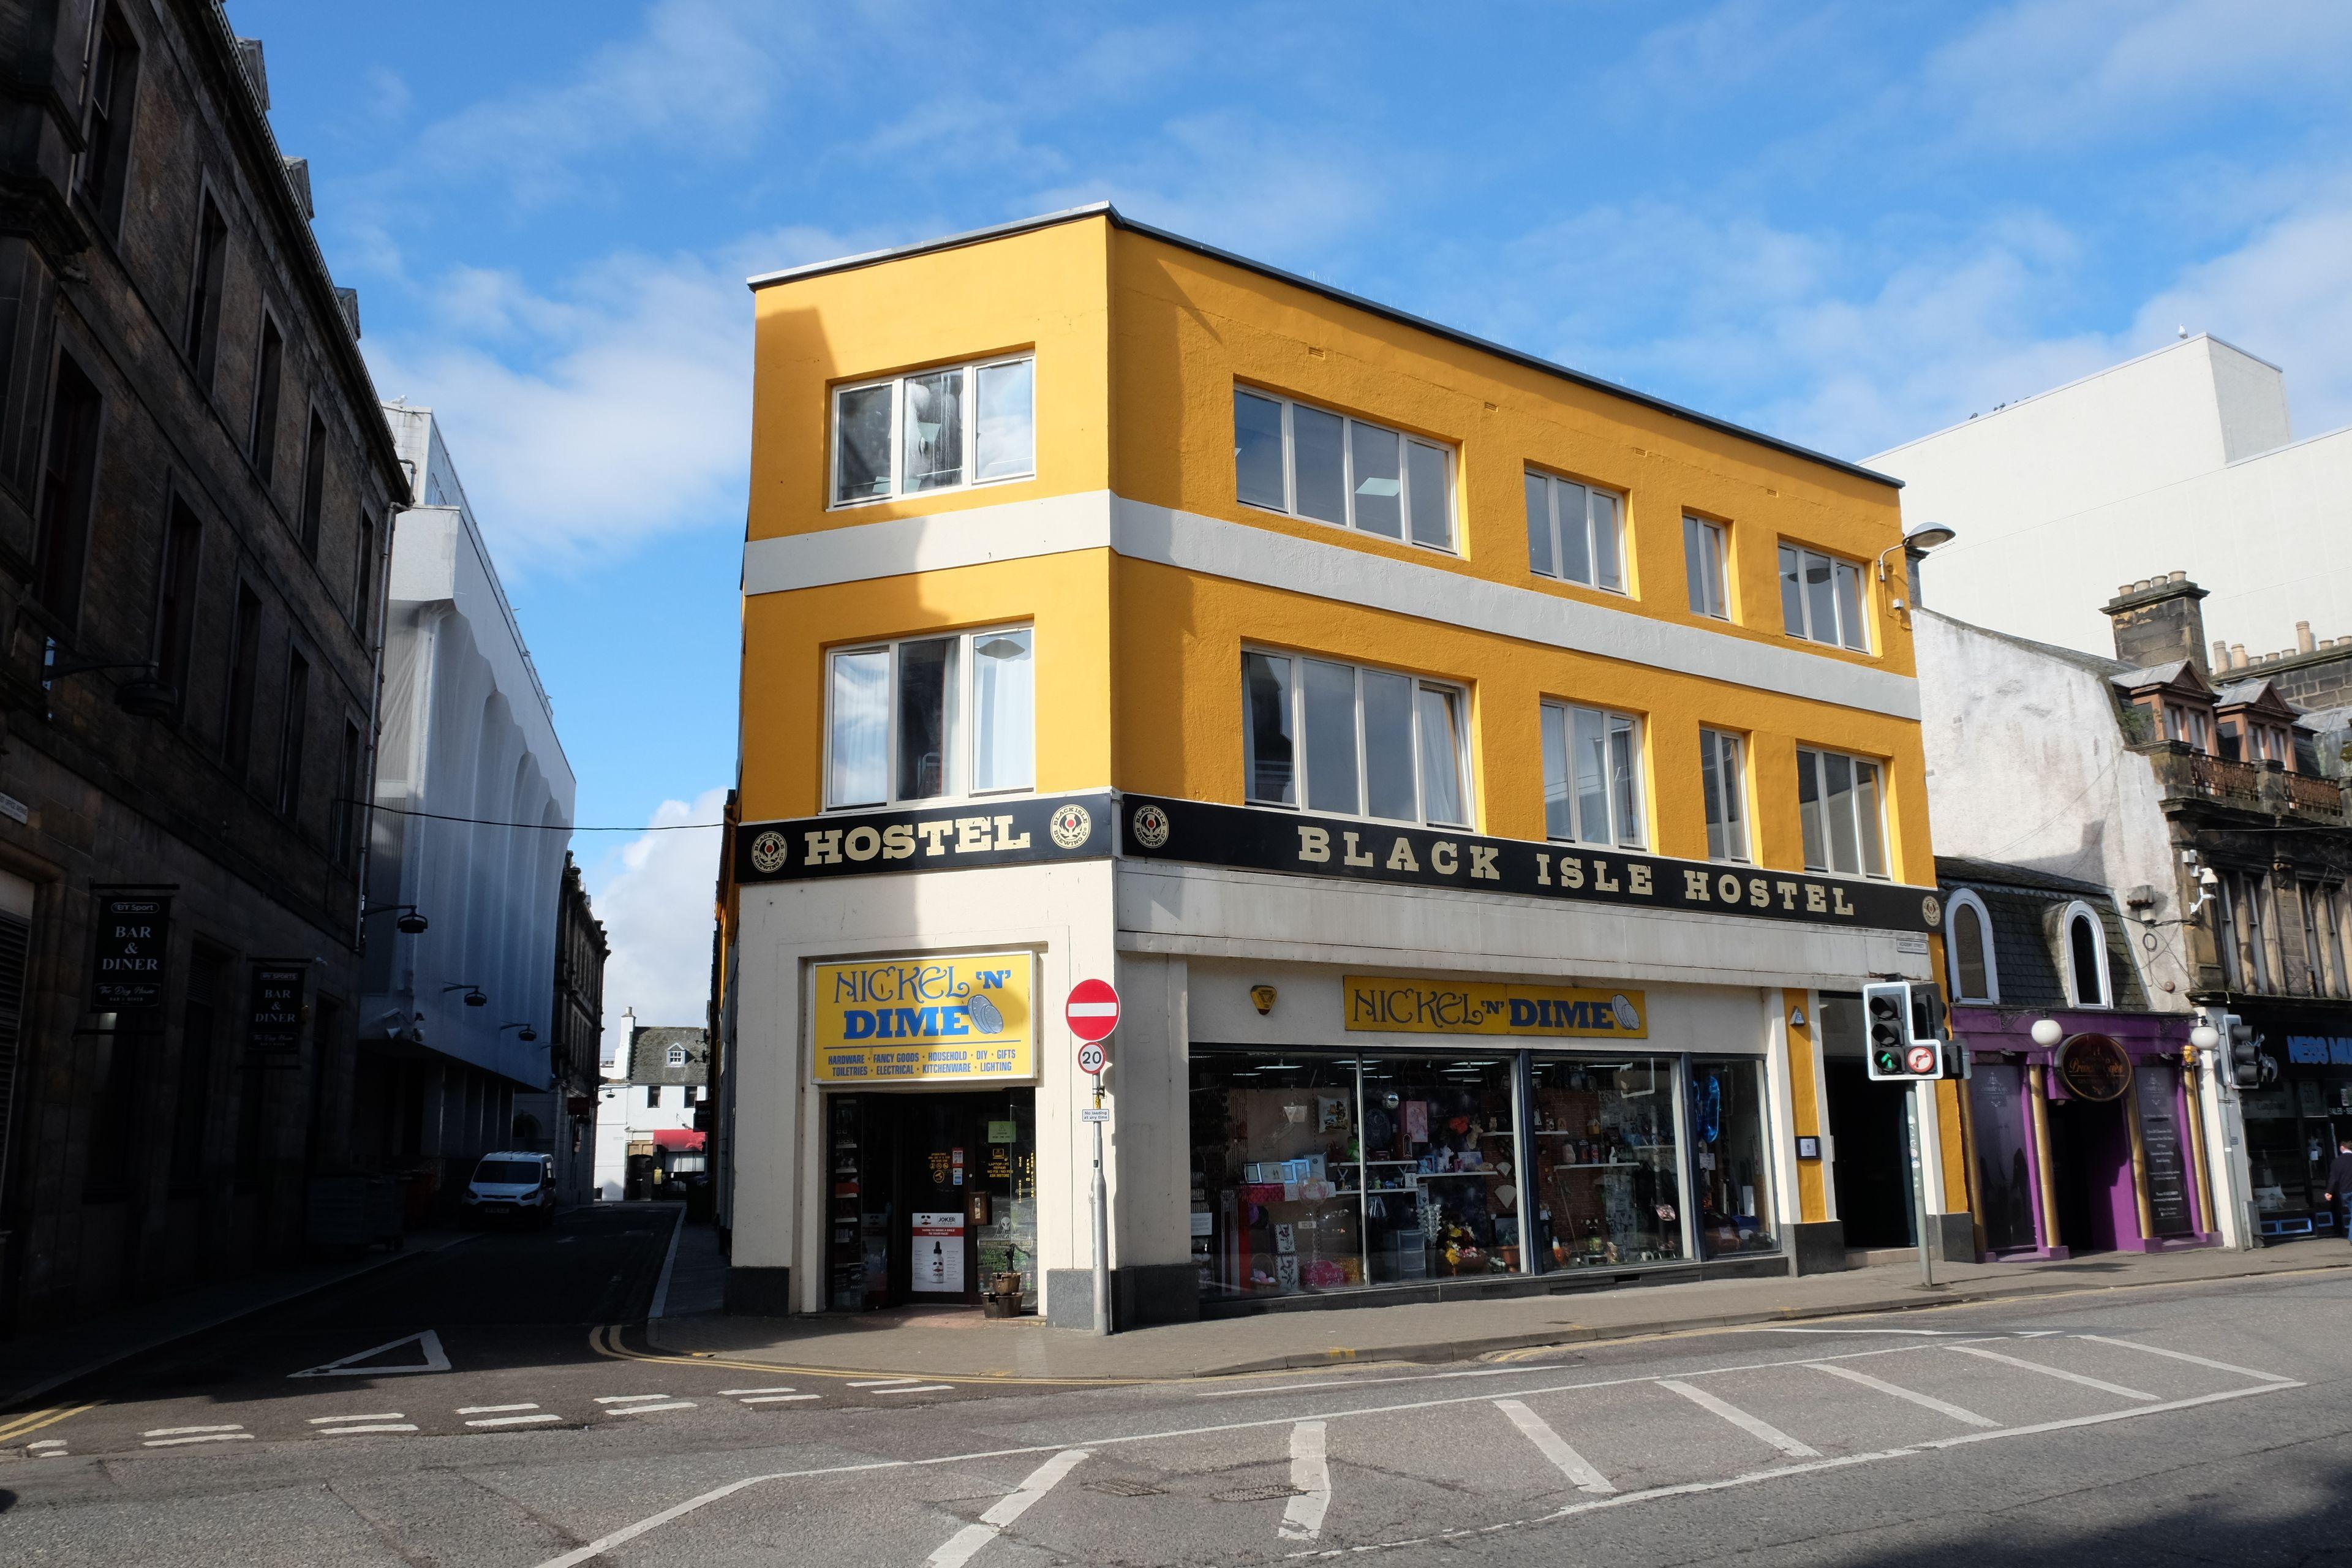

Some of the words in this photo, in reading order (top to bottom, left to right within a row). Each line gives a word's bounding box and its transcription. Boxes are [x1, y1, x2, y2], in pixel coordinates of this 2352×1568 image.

[1054, 807, 1075, 826] BLACK
[1075, 809, 1088, 824] ISLE
[804, 815, 1030, 866] HOSTEL
[1054, 830, 1083, 846] BREWING
[1298, 825, 1500, 880] BLACK
[1536, 853, 1653, 895] ISLE
[1684, 870, 1854, 916] HOSTEL
[115, 926, 151, 938] BAR
[124, 941, 138, 954] &
[102, 958, 158, 970] DINER
[834, 965, 970, 1004] NICKEL
[264, 989, 291, 998] BAR
[271, 1001, 281, 1011] &
[1353, 988, 1483, 1028] NICKEL
[1509, 999, 1615, 1029] DIME
[255, 1013, 296, 1022] DINER
[843, 1006, 970, 1039] DIME
[828, 1054, 865, 1066] HARDWARE
[873, 1053, 895, 1064] FANCY
[896, 1052, 919, 1063] GOODS
[928, 1051, 967, 1062] HOUSEHOLD
[976, 1050, 988, 1060] DIY
[997, 1049, 1016, 1060] GIFTS
[1082, 1051, 1102, 1064] 20
[2286, 1035, 2329, 1065] NESS
[832, 1066, 867, 1077] TOILETRIES
[876, 1065, 914, 1076] ELECTRICAL
[922, 1063, 971, 1074] KITCHENWARE
[980, 1061, 1012, 1072] LIGHTING
